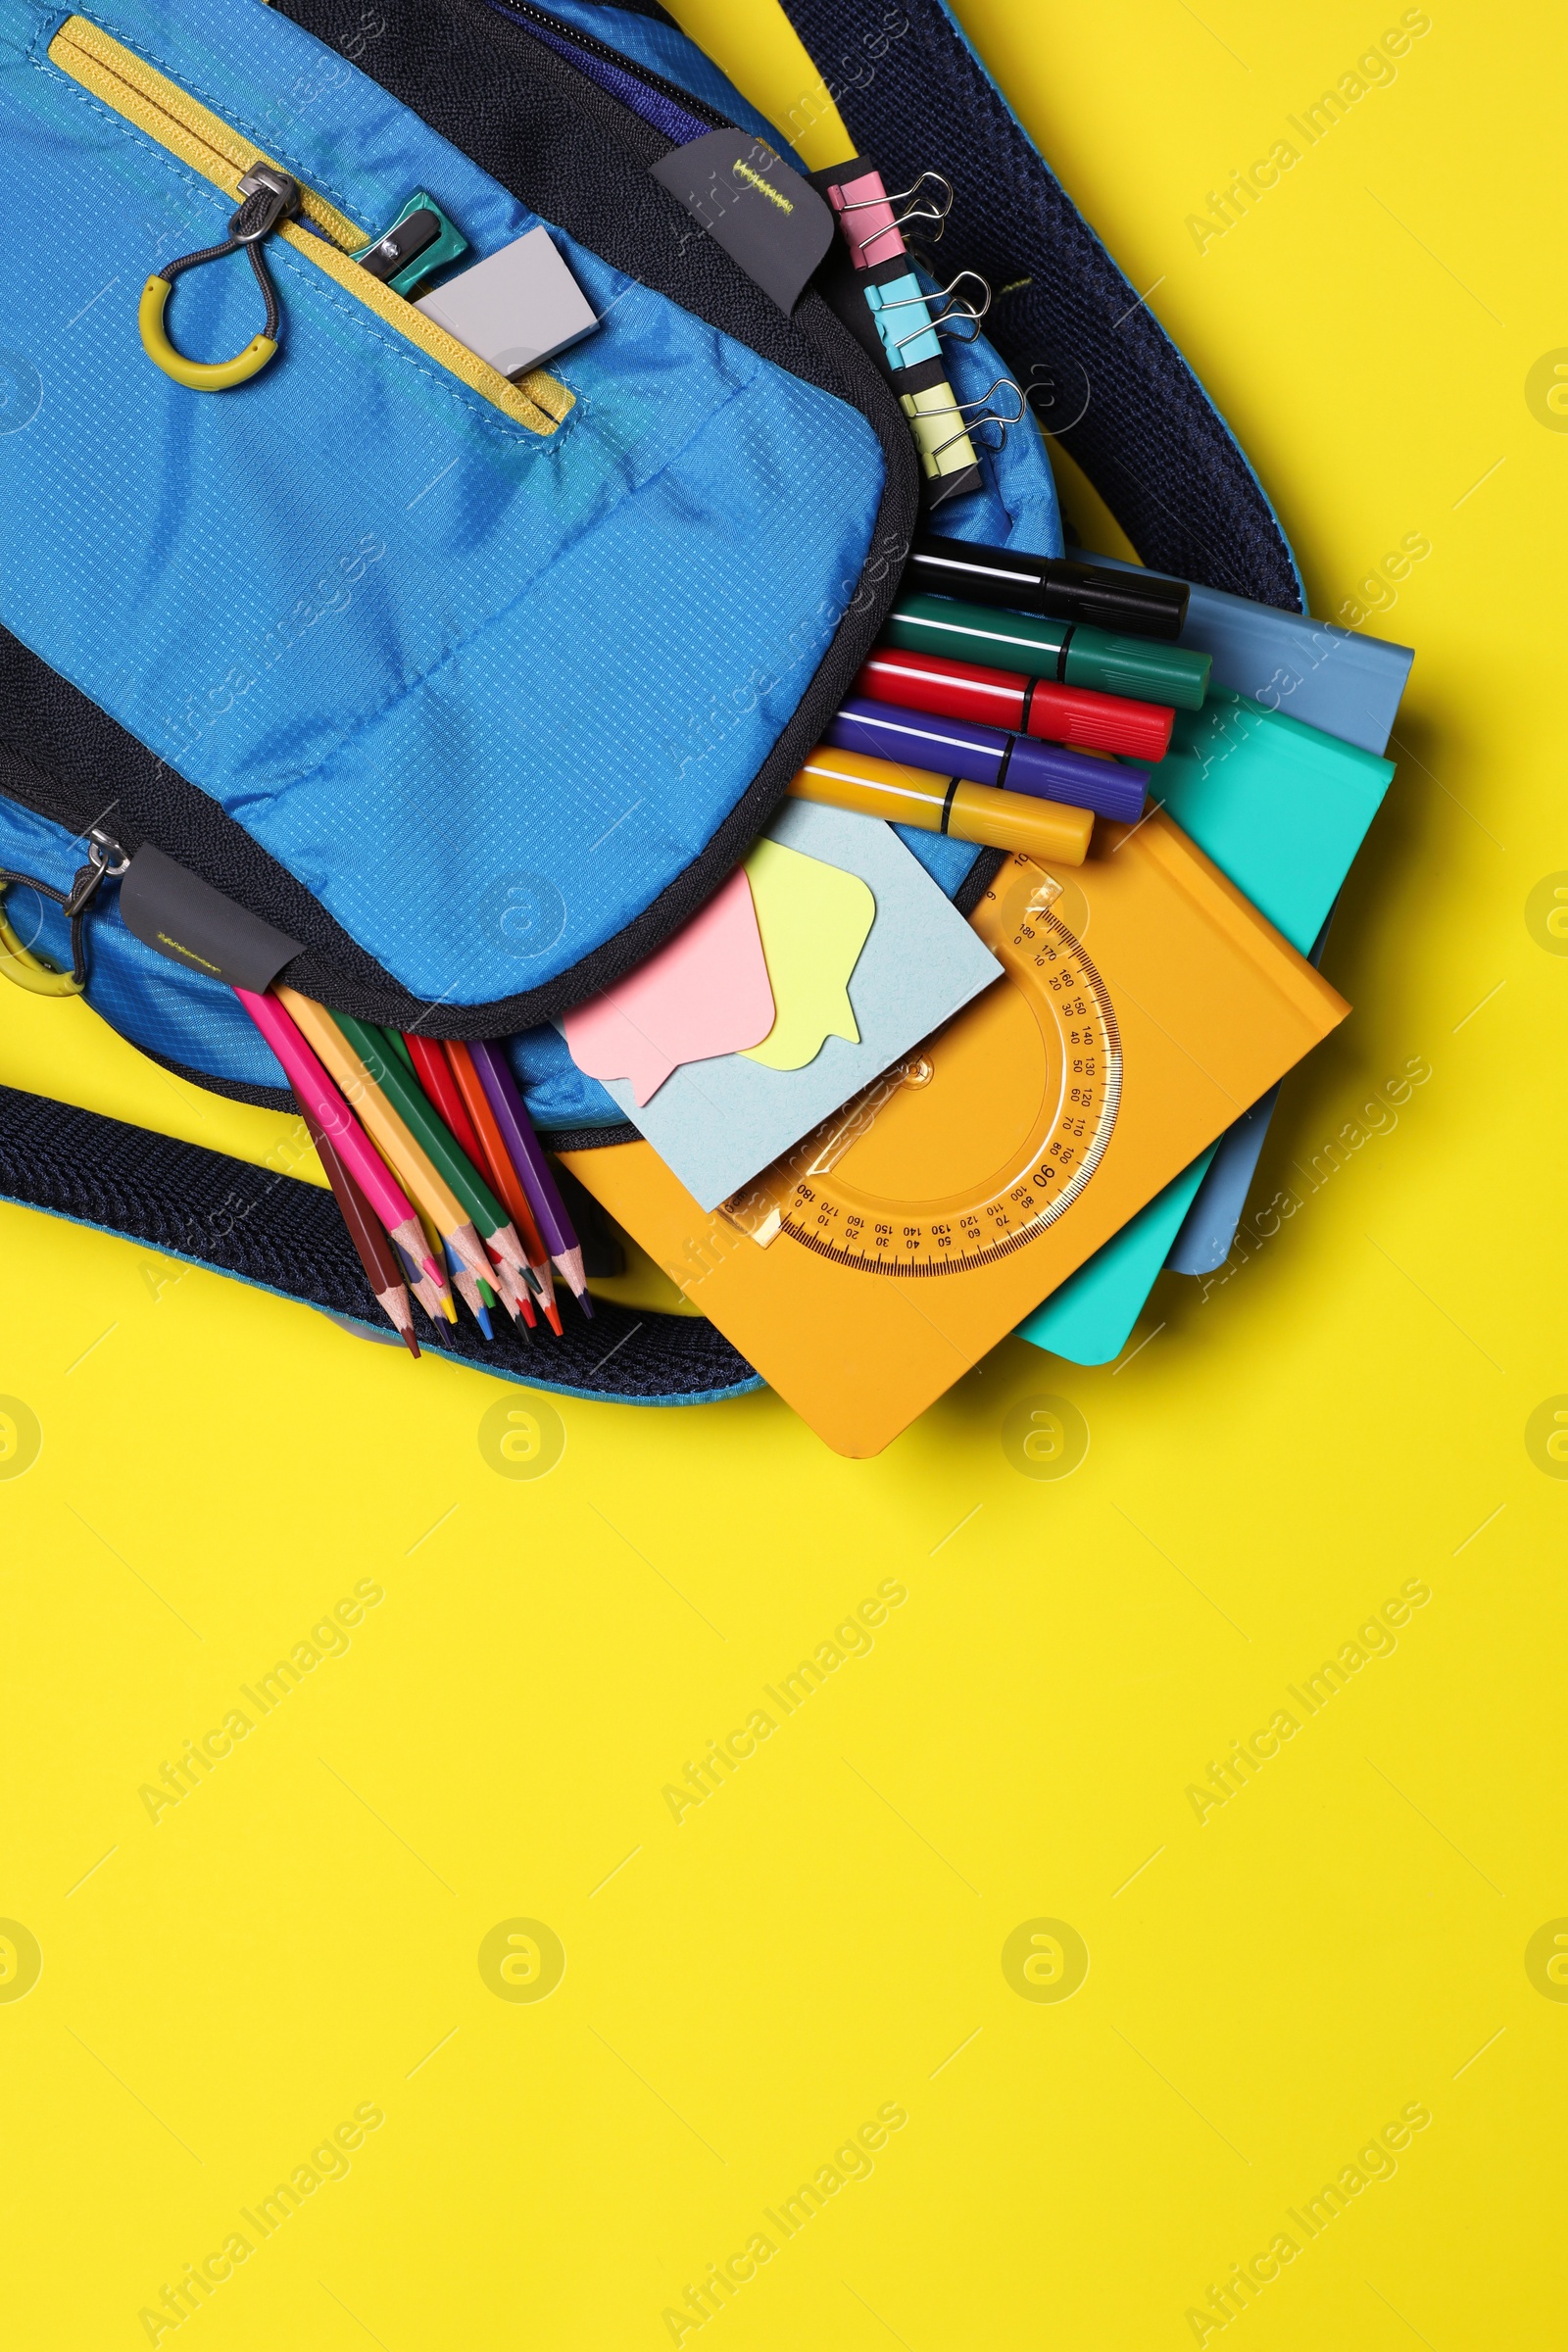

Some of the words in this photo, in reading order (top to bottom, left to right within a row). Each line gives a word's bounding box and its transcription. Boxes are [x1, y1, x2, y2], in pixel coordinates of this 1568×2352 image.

[1014, 853, 1029, 867] 10
[986, 891, 997, 901] 9
[1019, 923, 1036, 939] 180
[1013, 935, 1022, 945] 0
[1042, 945, 1057, 961] 170
[1033, 955, 1046, 967] 10
[1049, 976, 1062, 991] 20
[1058, 968, 1074, 988] 160
[1061, 1003, 1074, 1017] 30
[1072, 996, 1087, 1015] 150
[1070, 1031, 1081, 1045] 40
[1082, 1025, 1094, 1046] 140
[1072, 1059, 1083, 1073] 50
[1085, 1056, 1096, 1076] 130
[1070, 1088, 1081, 1102] 60
[1081, 1088, 1094, 1107] 120
[1061, 1116, 1074, 1130] 70
[1073, 1119, 1086, 1137] 110
[1050, 1142, 1062, 1156] 80
[1059, 1147, 1075, 1164] 100
[1032, 1164, 1055, 1188] 90
[797, 1184, 816, 1202] 180
[1010, 1185, 1027, 1201] 100
[724, 1202, 735, 1214] 0
[734, 1190, 749, 1207] cm
[794, 1199, 804, 1207] 0
[820, 1201, 839, 1217] 170
[986, 1202, 1004, 1216] 110
[1021, 1196, 1035, 1209] 80
[817, 1214, 830, 1227] 10
[847, 1215, 865, 1229] 160
[959, 1215, 979, 1229] 120
[996, 1214, 1010, 1227] 70
[845, 1228, 859, 1240] 20
[874, 1223, 894, 1235] 150
[903, 1226, 922, 1237] 140
[931, 1224, 952, 1235] 130
[967, 1228, 981, 1239] 60
[875, 1237, 890, 1248] 30
[906, 1239, 920, 1250] 40
[937, 1236, 952, 1248] 50
